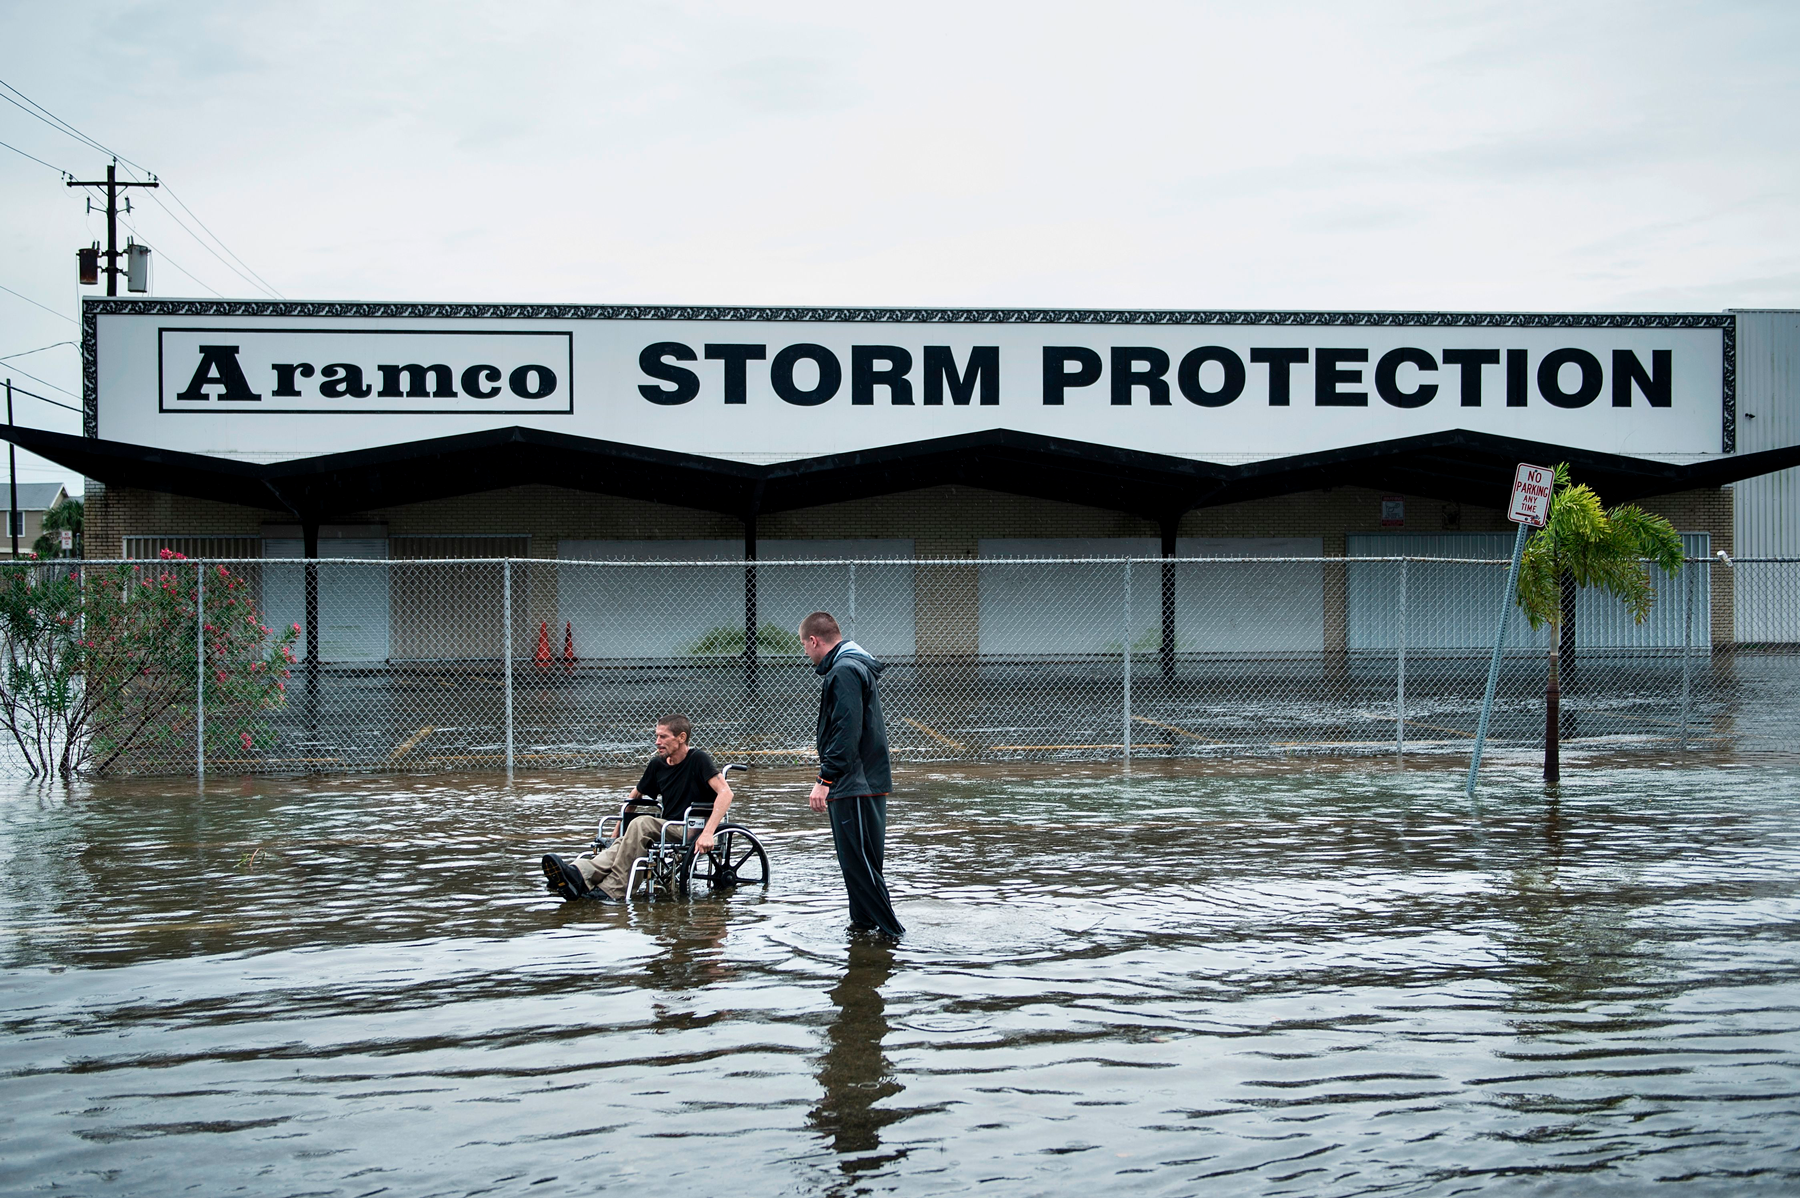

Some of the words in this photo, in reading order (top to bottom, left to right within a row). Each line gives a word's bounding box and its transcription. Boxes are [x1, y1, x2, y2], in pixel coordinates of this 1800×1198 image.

[176, 344, 558, 402] Aramco
[637, 341, 1000, 406] STORM
[1042, 345, 1673, 409] PROTECTION
[1527, 470, 1542, 483] NO
[1516, 481, 1549, 498] PARKING
[1523, 495, 1538, 504] ANY
[1521, 503, 1537, 513] TIME
